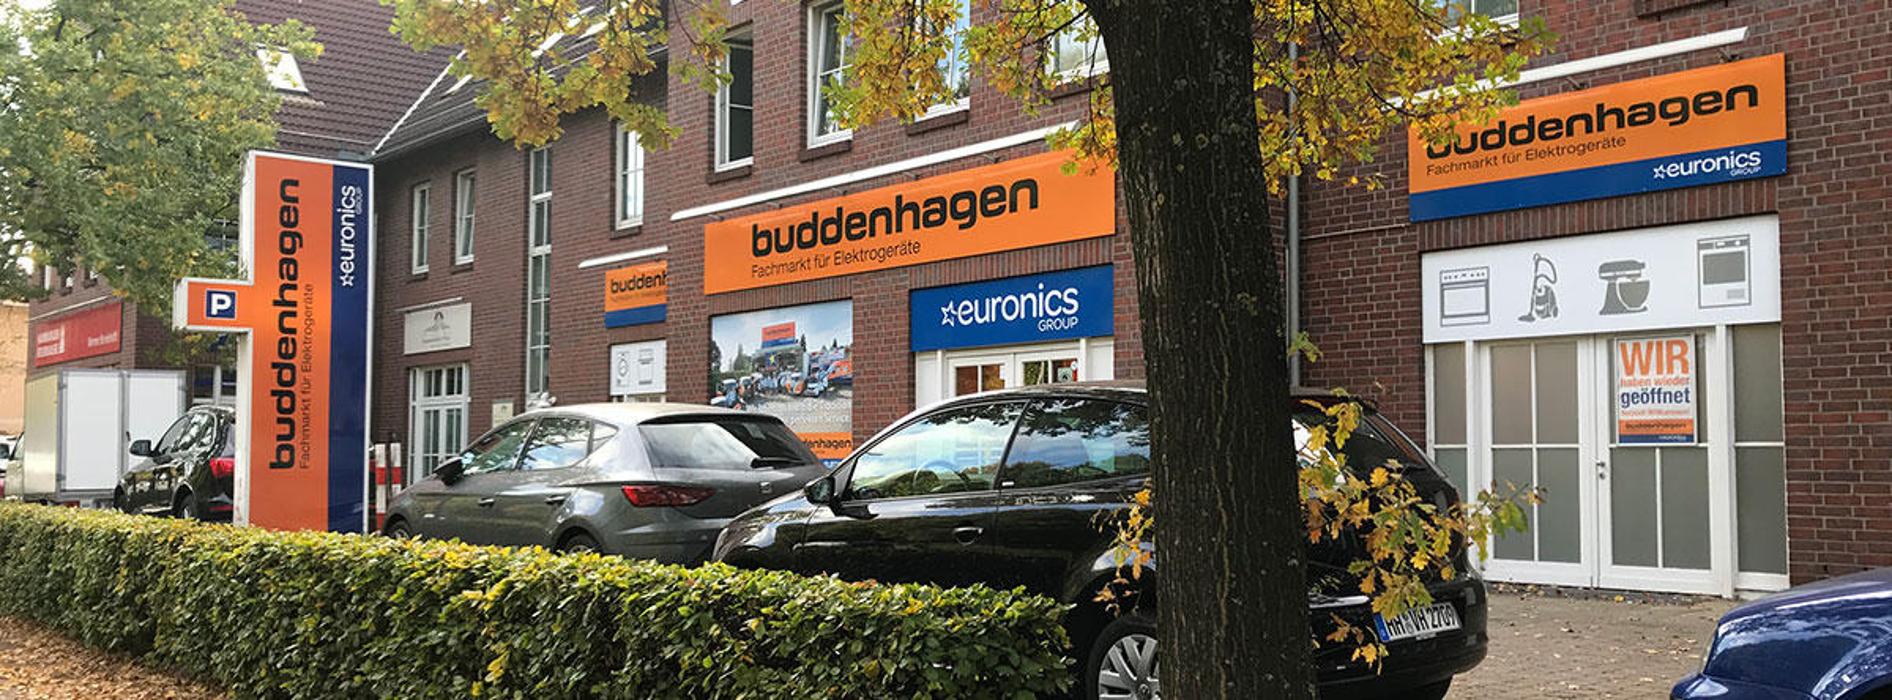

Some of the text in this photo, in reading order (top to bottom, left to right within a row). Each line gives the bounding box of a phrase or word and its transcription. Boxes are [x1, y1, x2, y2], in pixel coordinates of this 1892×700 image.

[1426, 136, 1626, 177] Fachmarkt für Elektrogeräte
[1666, 151, 1761, 178] euronics
[1729, 166, 1761, 177] GROUP
[336, 185, 356, 274] euronics
[752, 178, 1039, 258] buddenhagen
[751, 239, 922, 279] Fachmarkt für Elektrogeräte
[210, 293, 232, 316] P
[269, 178, 304, 470] buddenhagen
[958, 283, 1080, 326] euronics
[1037, 317, 1079, 332] GROUP
[299, 283, 316, 469] Fachmarkt für Elektrogeräte
[1620, 339, 1689, 376] WIR
[1620, 387, 1691, 409] geöffnet
